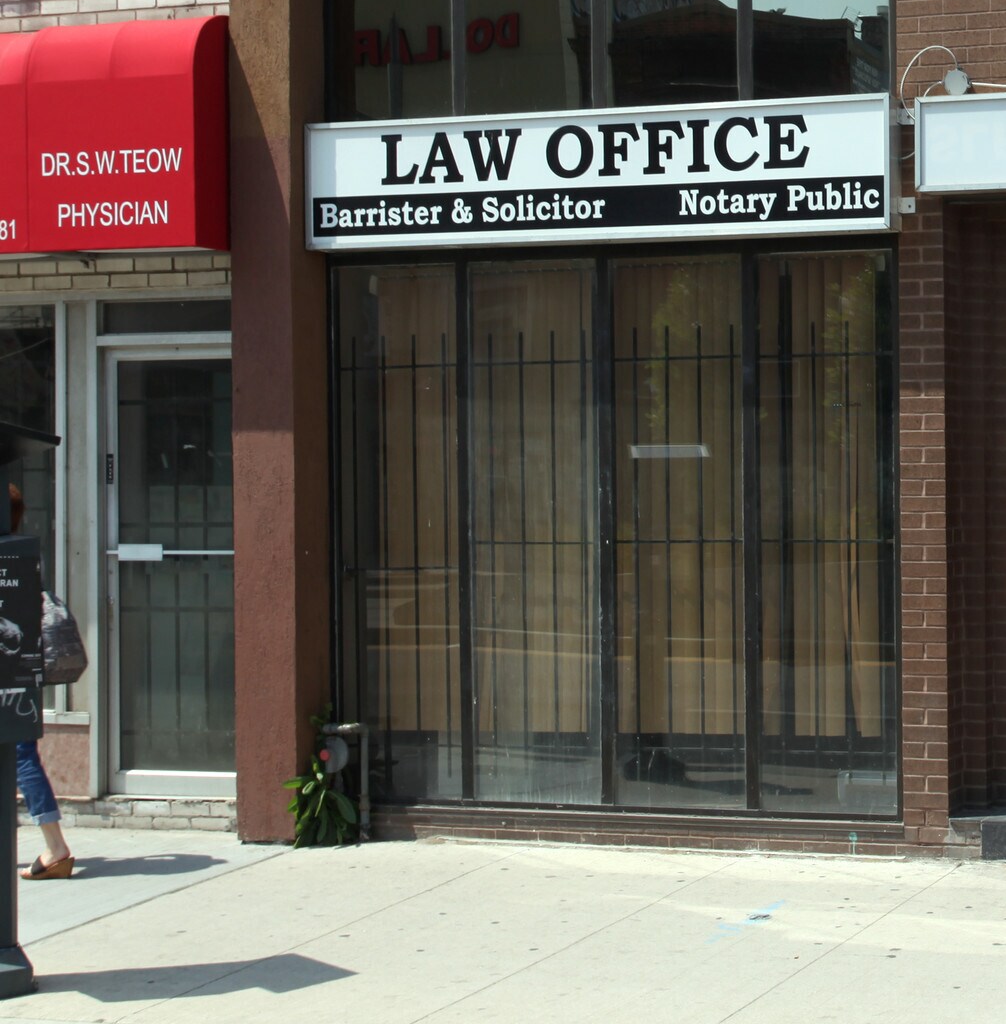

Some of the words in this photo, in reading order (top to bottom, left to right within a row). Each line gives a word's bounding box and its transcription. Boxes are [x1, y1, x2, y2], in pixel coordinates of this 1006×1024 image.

[381, 128, 522, 186] LAW
[545, 114, 810, 179] OFFICE
[57, 201, 168, 227] PHYSICIAN
[320, 200, 440, 229] Barrister
[451, 199, 473, 224] &
[481, 194, 606, 222] Solicitor
[679, 188, 776, 221] Notary
[786, 183, 880, 212] Public
